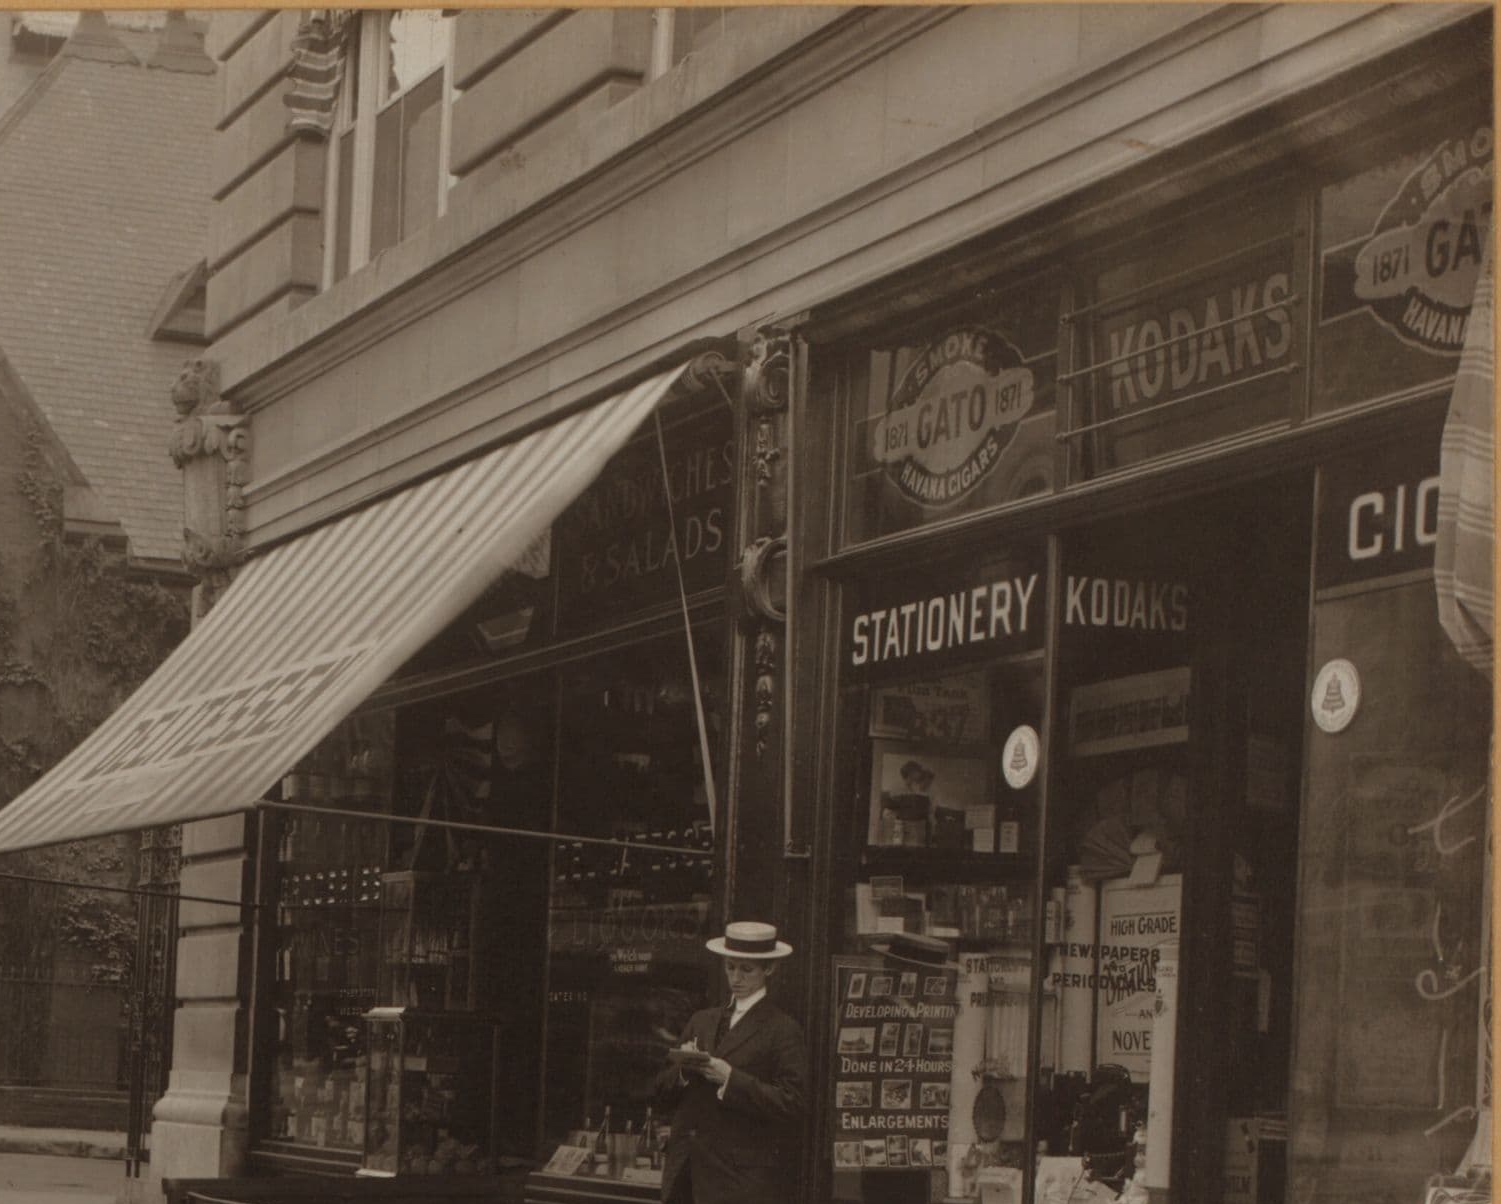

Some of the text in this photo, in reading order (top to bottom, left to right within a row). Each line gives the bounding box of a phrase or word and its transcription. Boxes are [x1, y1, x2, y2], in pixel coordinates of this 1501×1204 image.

[1371, 243, 1410, 287] 1871
[914, 331, 989, 386] SMOKE
[1107, 272, 1292, 411] KODAKS
[884, 381, 1022, 453] 1871 GATO 1871
[899, 436, 999, 500] HAVANA CIGARS
[604, 507, 723, 587] SALADS
[852, 573, 1189, 667] STATIONERY KODAKS
[1110, 915, 1178, 937] HIGH GRADE
[845, 1002, 908, 1019] DEVELOPING
[841, 1057, 953, 1074] DONE IN 24 HOURS
[842, 1112, 950, 1130] ENLARGEMENTS
